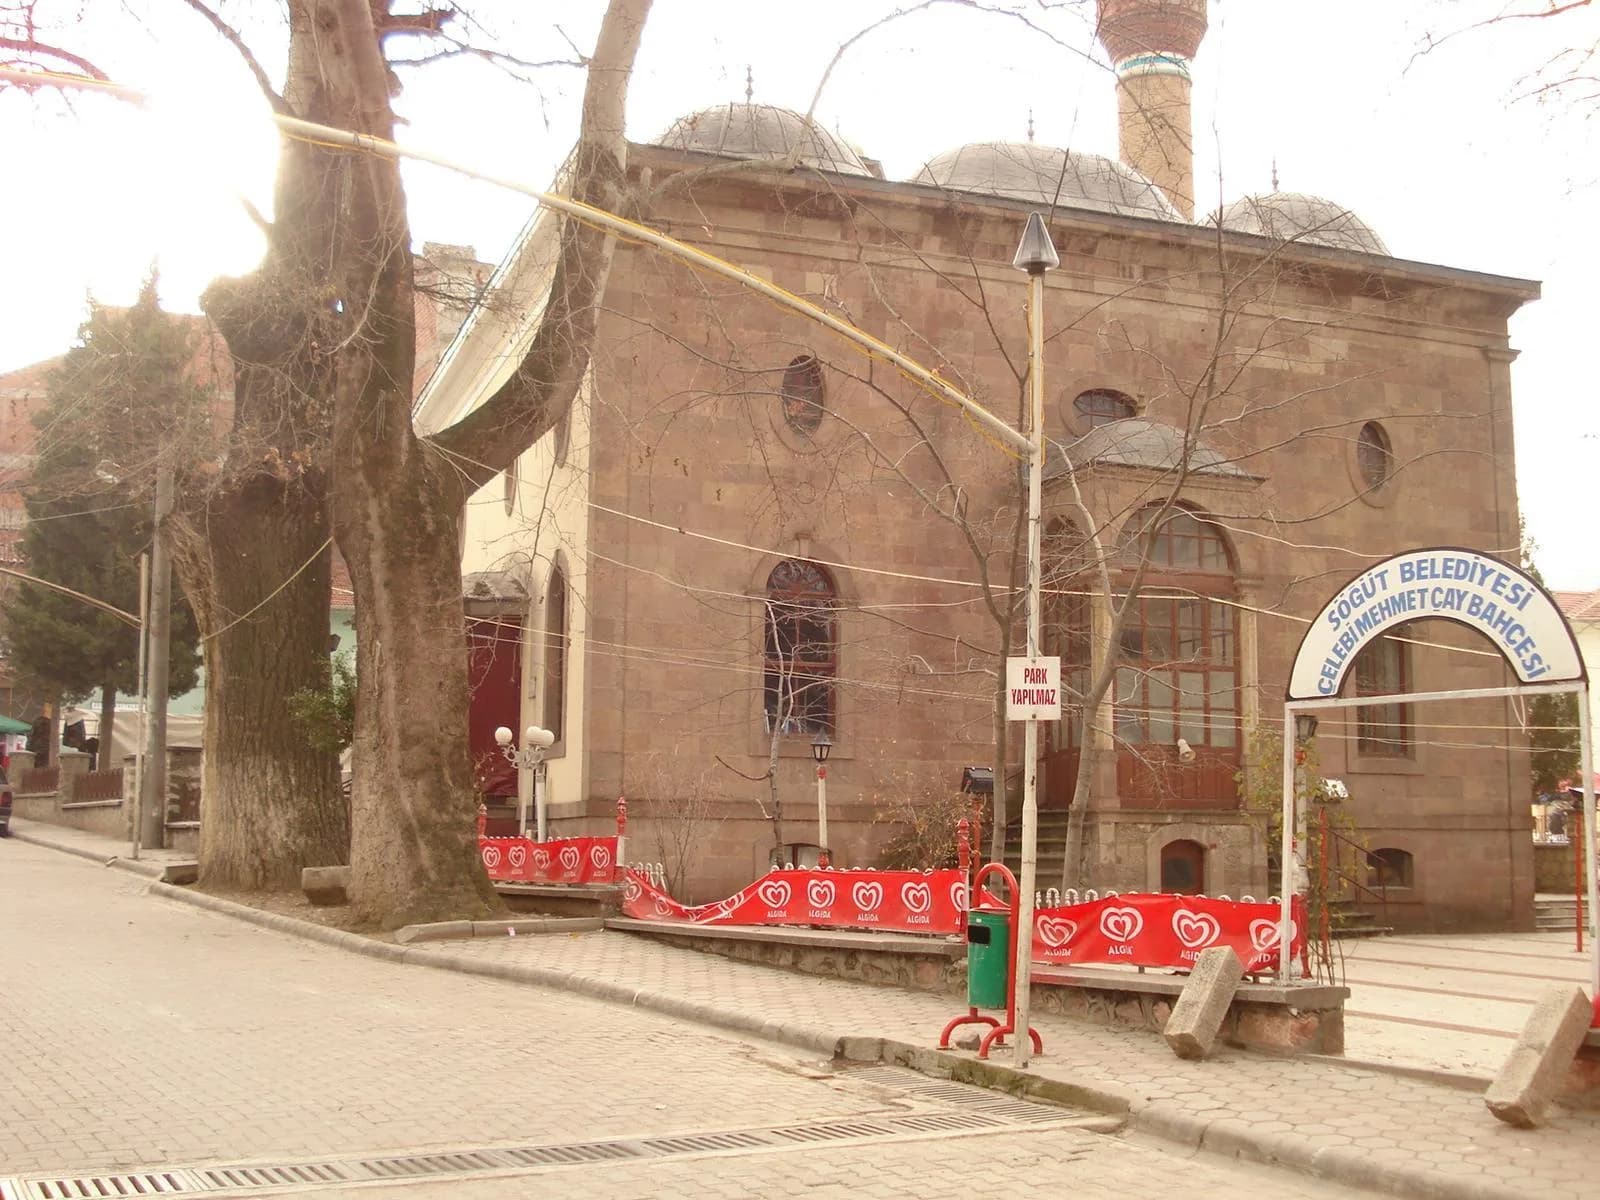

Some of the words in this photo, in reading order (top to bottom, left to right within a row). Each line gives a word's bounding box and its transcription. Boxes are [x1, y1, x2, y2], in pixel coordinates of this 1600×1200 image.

[1400, 556, 1536, 611] BELEDİYESİ
[1354, 587, 1429, 637] MEHMET
[1466, 593, 1551, 679] BAHÇESİ
[1024, 668, 1047, 684] PARK
[1011, 689, 1056, 705] YAPILMAZ
[857, 913, 879, 922] ALGIDA
[906, 914, 930, 924] ALGIDA
